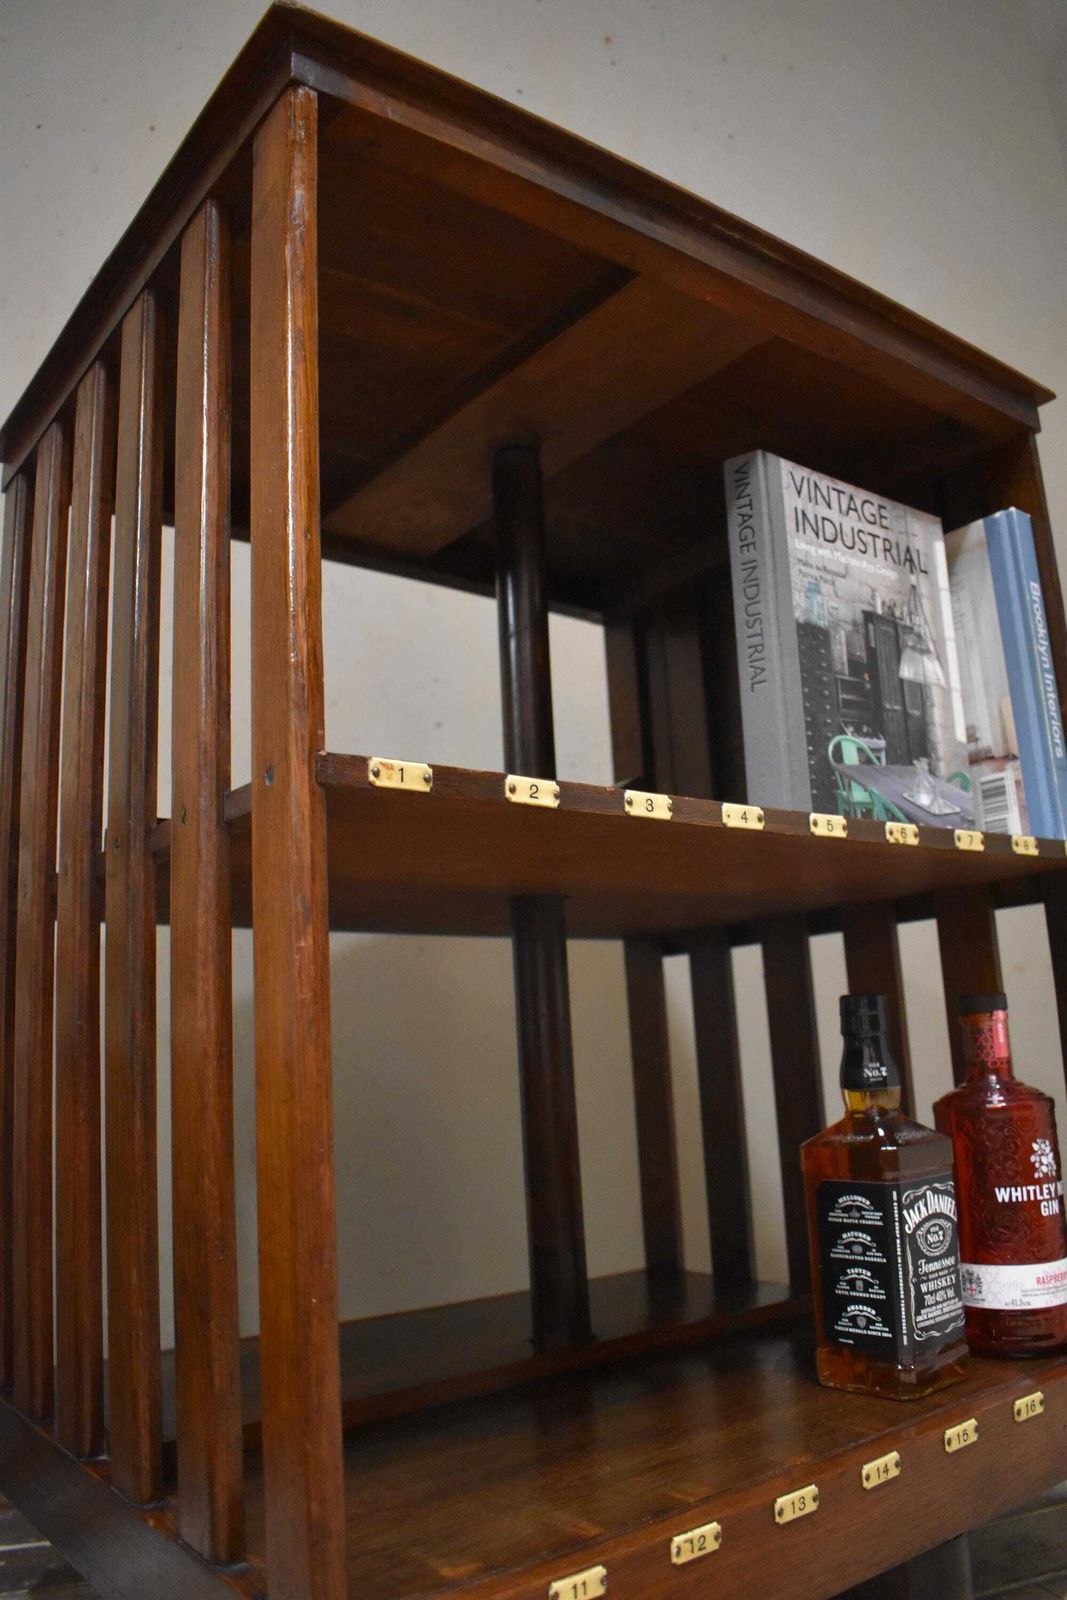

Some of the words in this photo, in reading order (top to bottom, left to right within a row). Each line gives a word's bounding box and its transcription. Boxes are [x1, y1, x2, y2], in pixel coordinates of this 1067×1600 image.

[734, 462, 757, 554] VINTAGE
[789, 470, 889, 530] VINTAGE
[794, 506, 928, 575] INDUSTRIAL
[741, 559, 768, 693] INDUSTRIAL
[1029, 580, 1050, 670] Brooklyn
[1043, 672, 1063, 758] Interiors
[398, 767, 405, 783] 1
[529, 784, 539, 799] 2
[645, 798, 654, 813] 3
[740, 810, 749, 824] 4
[826, 820, 835, 832] 5
[899, 826, 907, 839] 6
[967, 834, 974, 846] 7
[995, 1182, 1055, 1203] WHITLEY
[903, 1198, 928, 1234] JACK
[926, 1190, 957, 1221] DANIEL
[1041, 1199, 1059, 1216] GIN
[842, 1231, 871, 1241] MATURED
[846, 1268, 871, 1277] TASTED
[918, 1256, 956, 1274] Tennessee
[920, 1273, 956, 1293] WHISKEY
[847, 1304, 876, 1315] AWARDED
[1025, 1399, 1037, 1416] 16
[956, 1429, 970, 1445] 15
[876, 1462, 890, 1479] 14
[790, 1496, 806, 1514] 13
[689, 1534, 707, 1554] 12
[570, 1580, 589, 1599] 11
